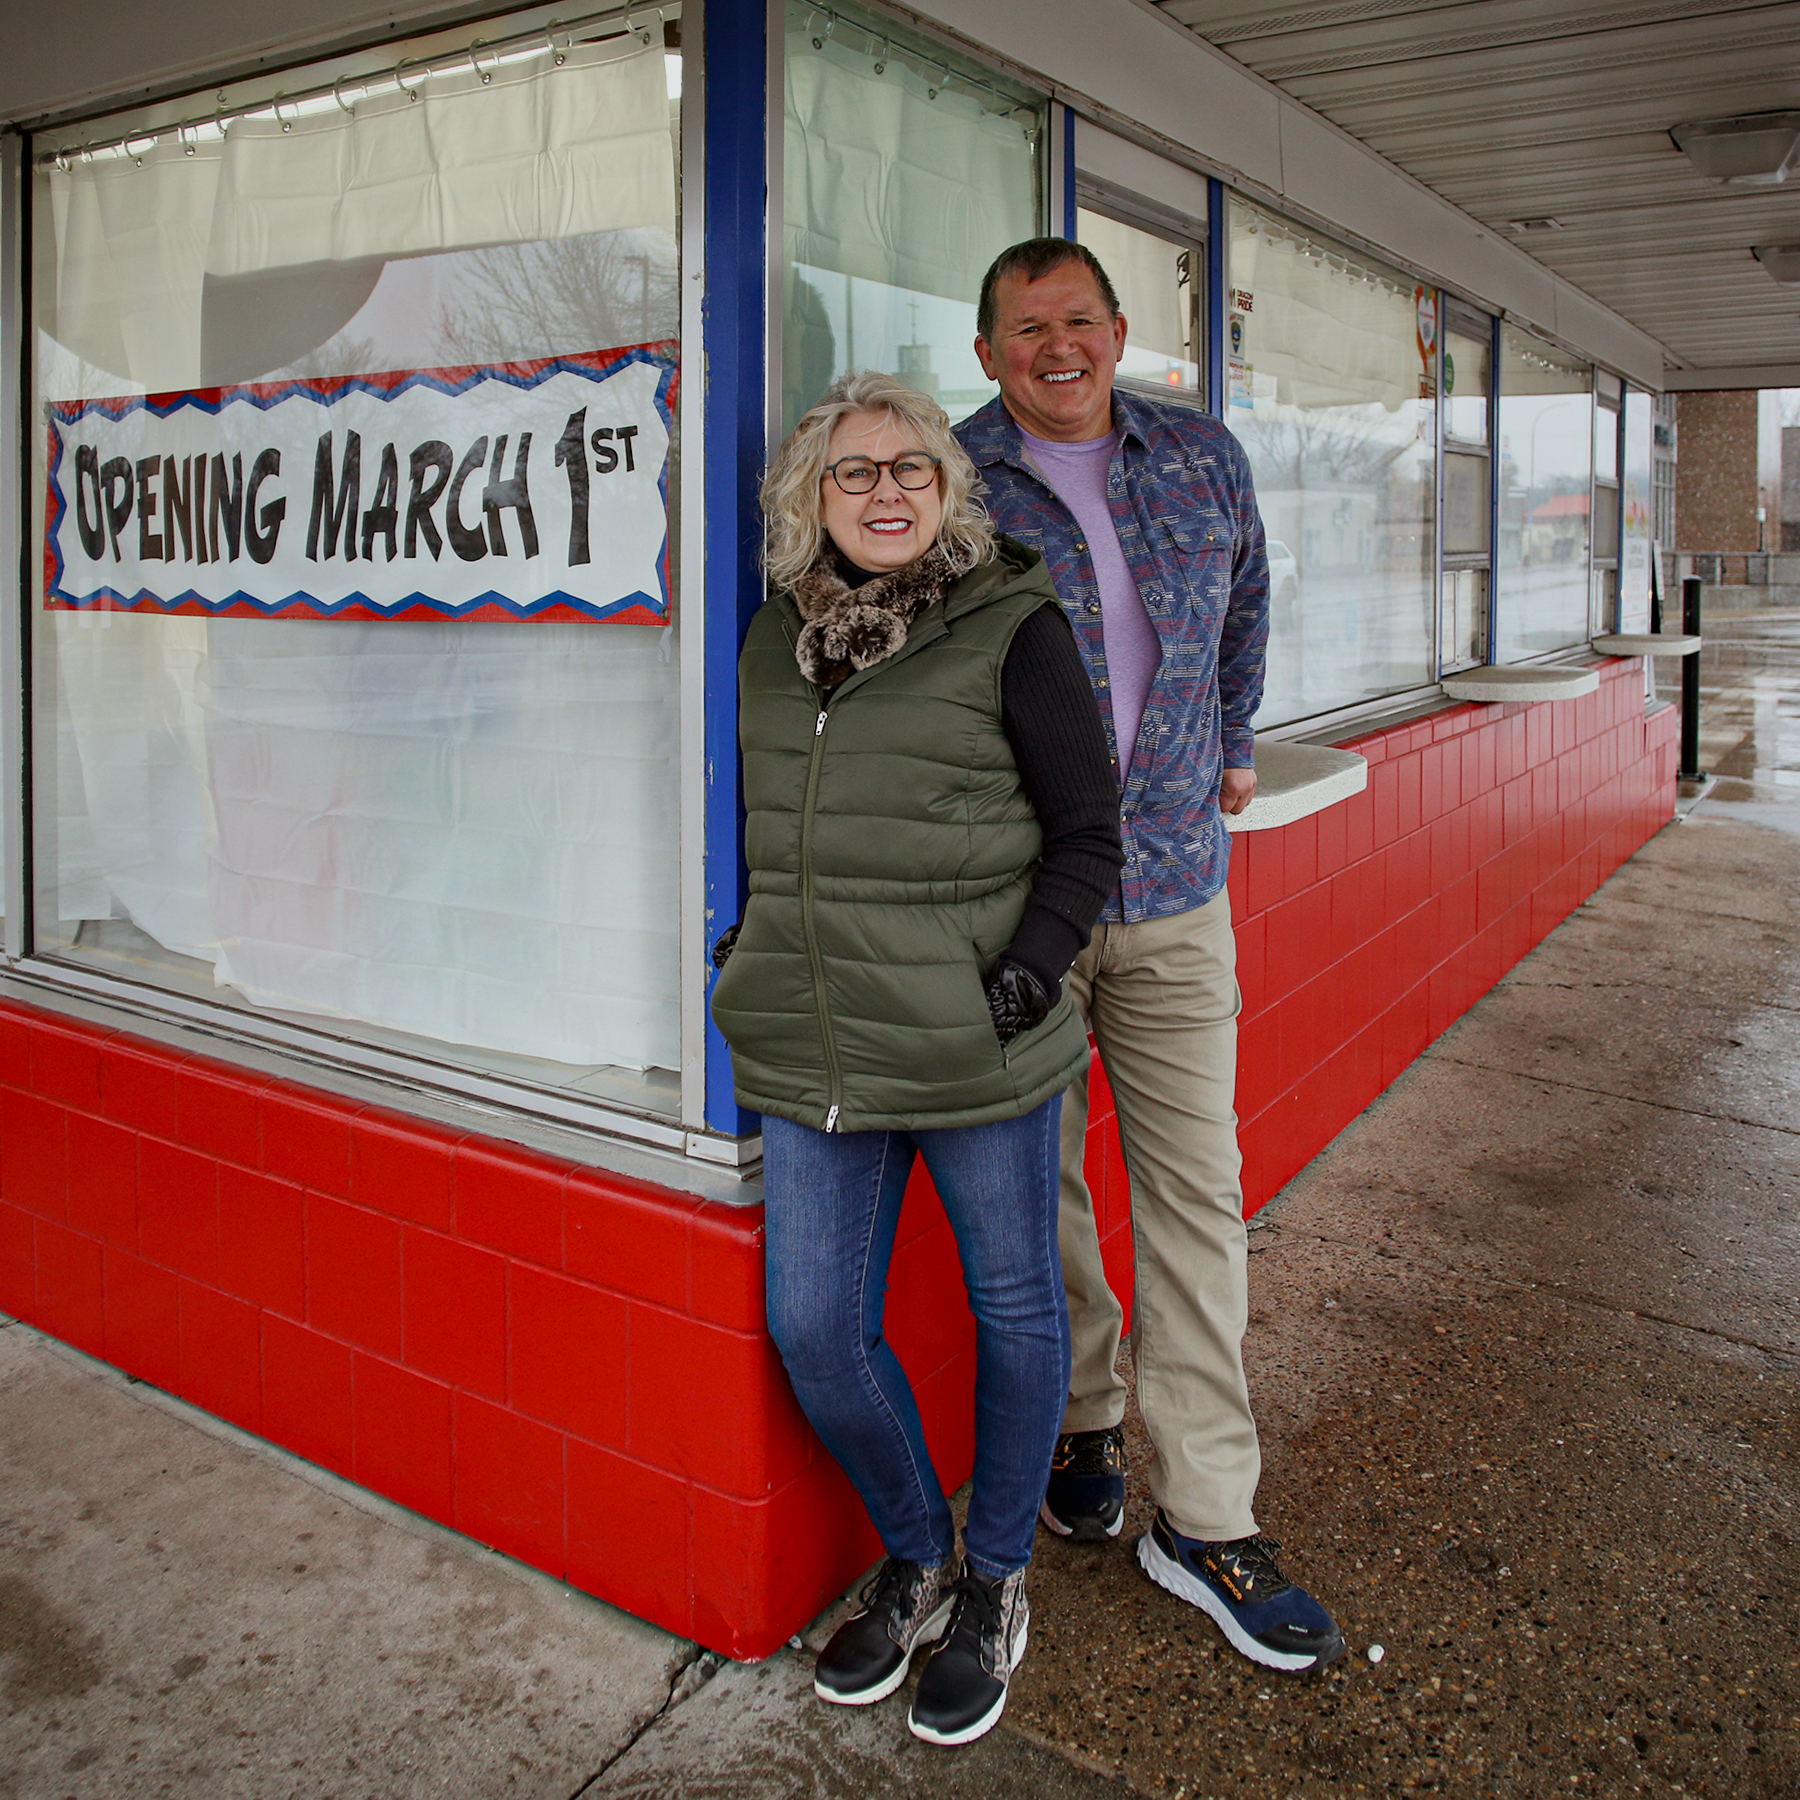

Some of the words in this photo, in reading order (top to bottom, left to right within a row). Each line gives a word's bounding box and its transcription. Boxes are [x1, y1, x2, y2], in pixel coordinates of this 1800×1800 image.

[1237, 298, 1254, 312] PRIDE
[75, 443, 286, 565] OPENING
[305, 428, 539, 563] MARCH
[1221, 1573, 1243, 1601] alance
